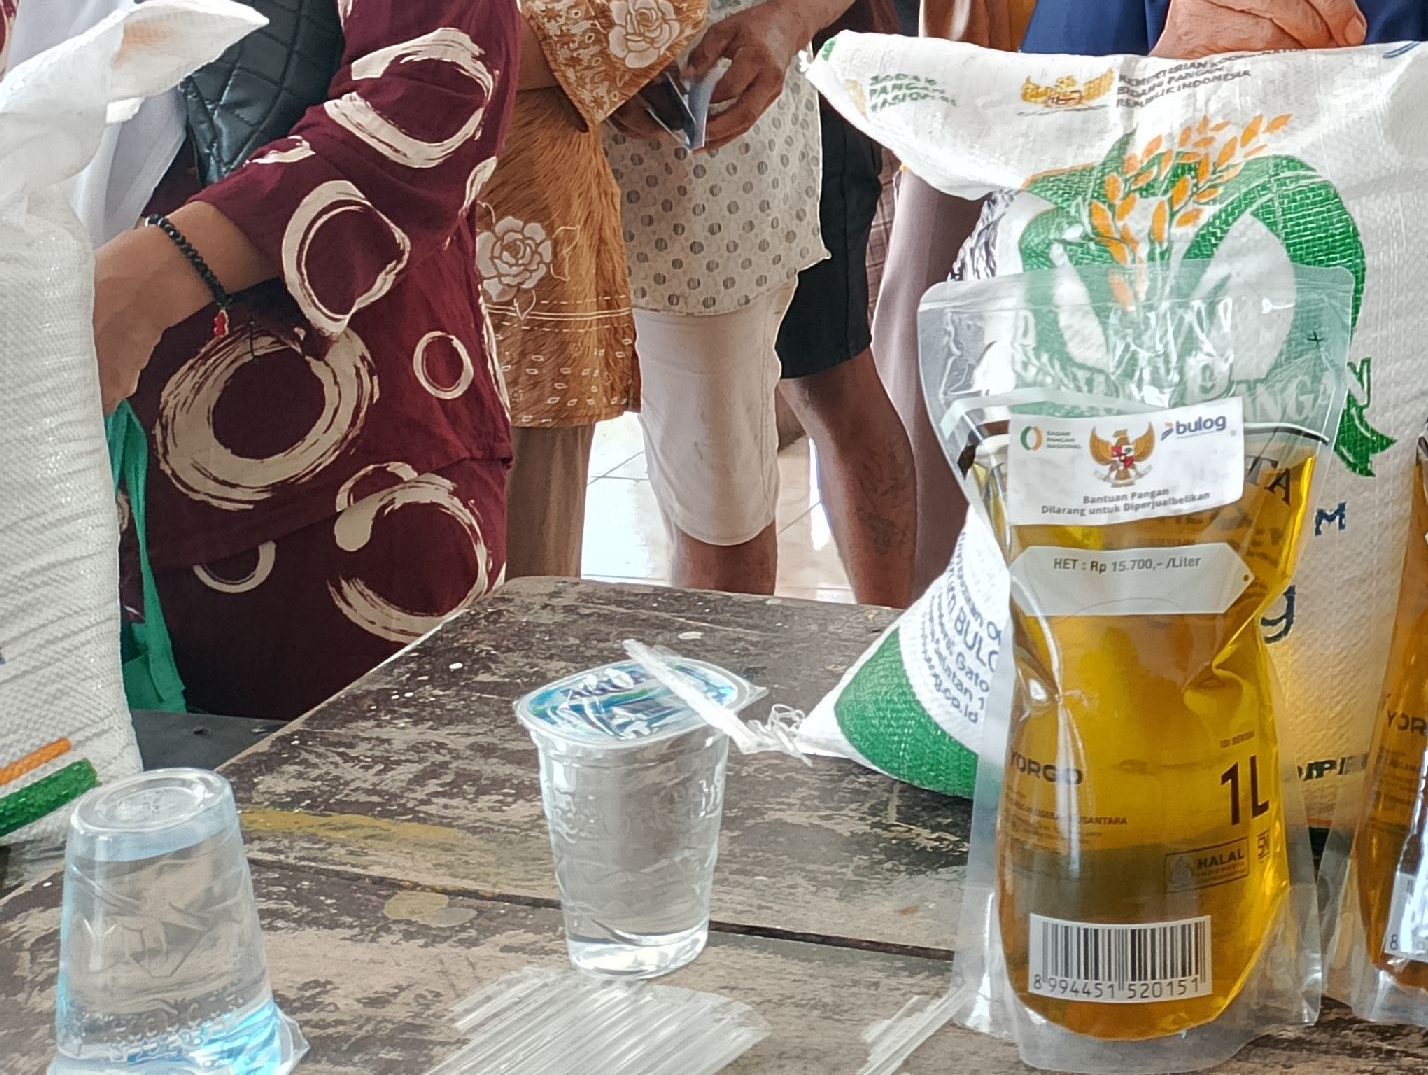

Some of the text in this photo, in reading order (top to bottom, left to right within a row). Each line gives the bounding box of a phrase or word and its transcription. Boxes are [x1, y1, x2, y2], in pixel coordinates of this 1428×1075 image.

[1175, 415, 1227, 435] bulog
[1041, 491, 1211, 516] Dilarang untuk Diperjualbelikan
[1084, 488, 1170, 505] Bantuan Pangan
[1053, 557, 1079, 570] HET
[1090, 560, 1107, 574] Rp
[1165, 556, 1202, 570] /Liter
[1221, 754, 1270, 826] 1L
[1197, 847, 1245, 869] HALAL
[1048, 977, 1116, 1000] 994451
[1126, 977, 1200, 1000] 520151
